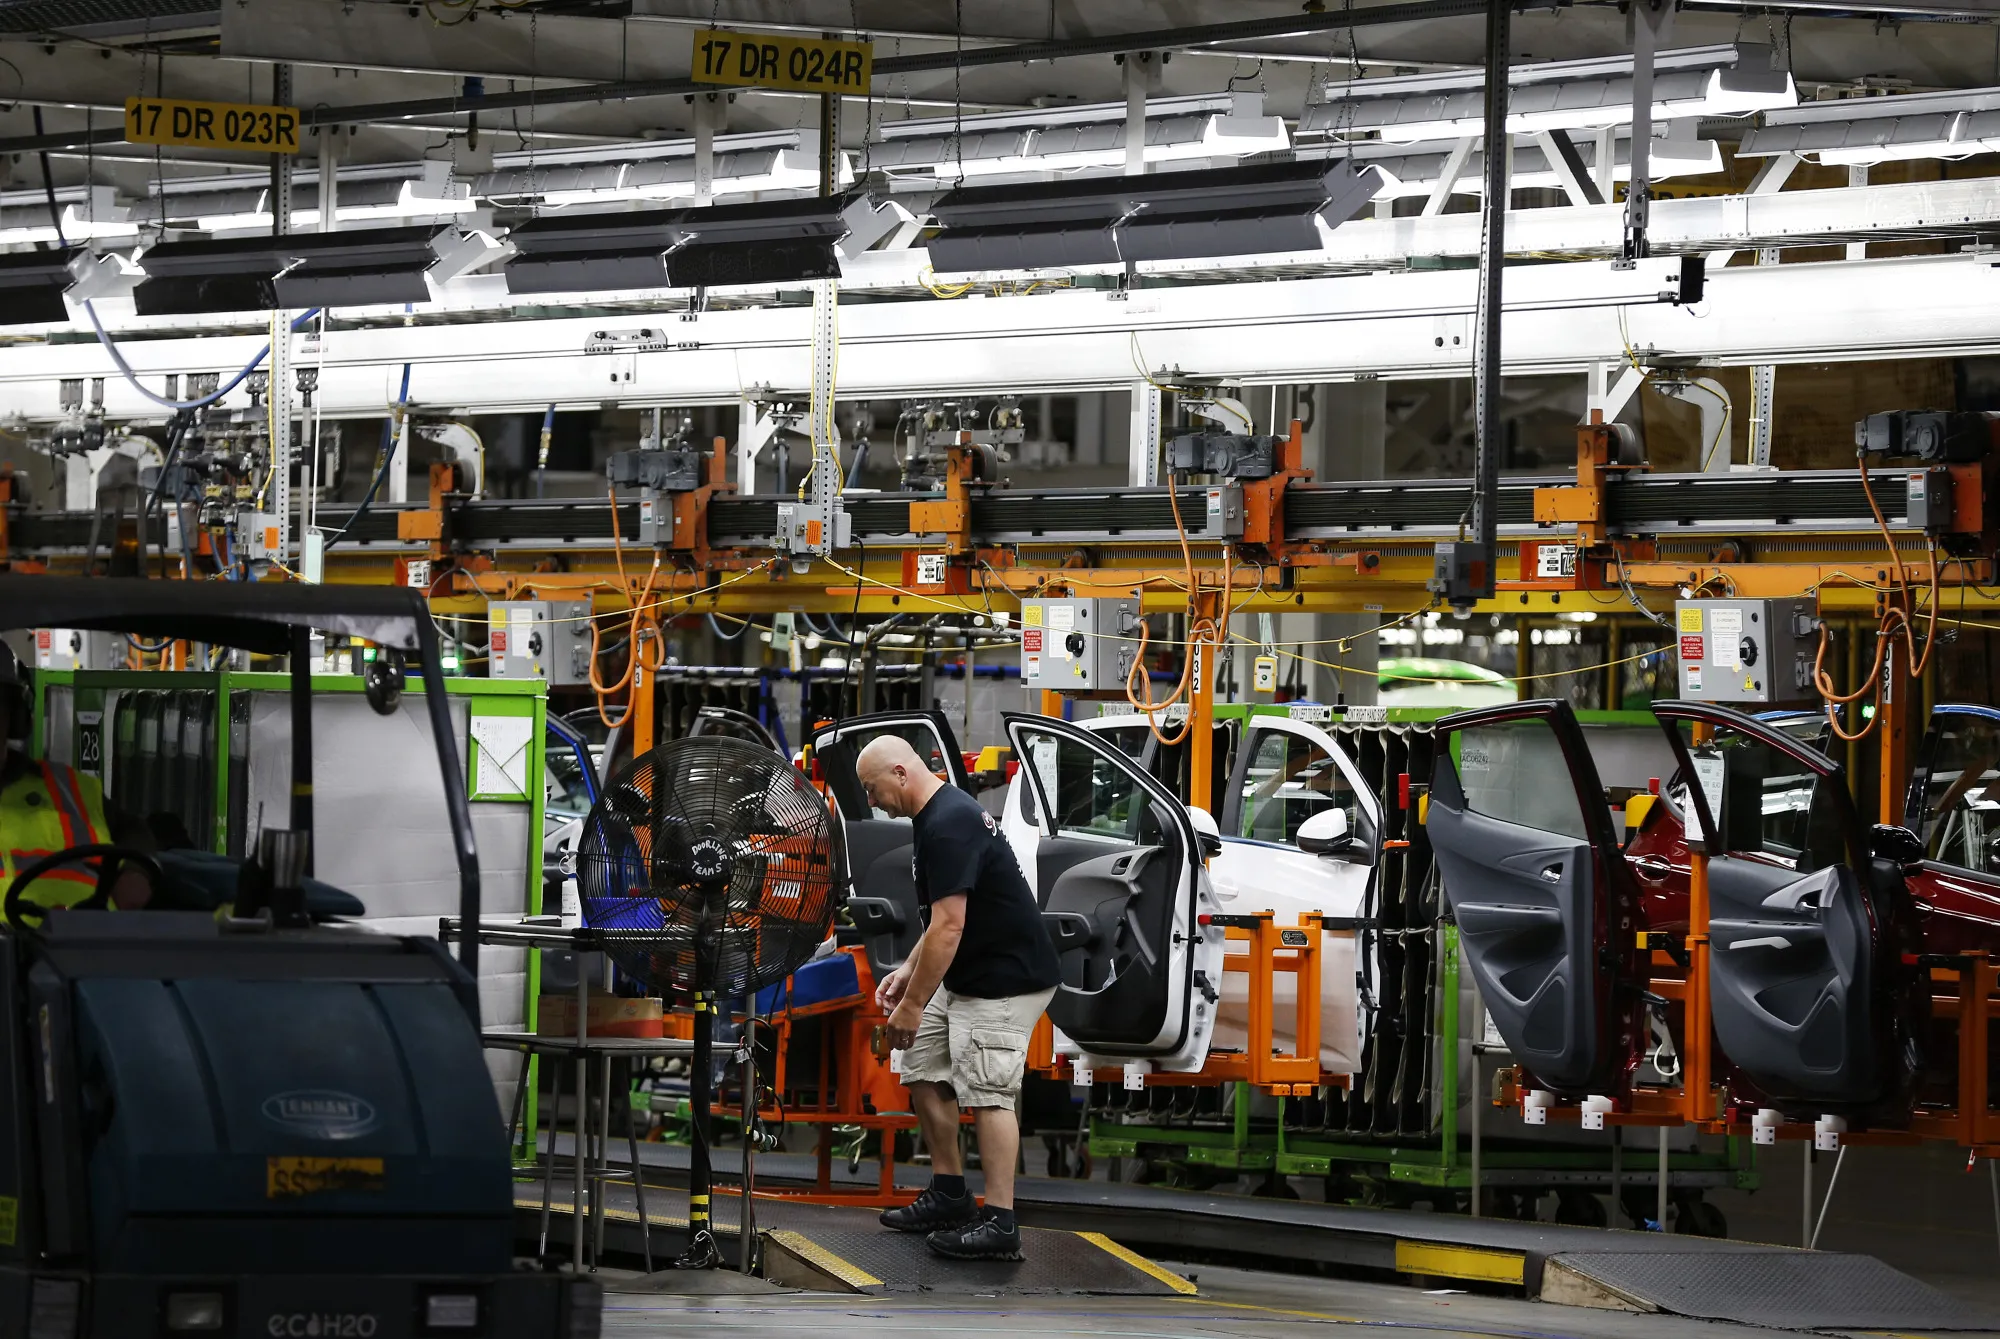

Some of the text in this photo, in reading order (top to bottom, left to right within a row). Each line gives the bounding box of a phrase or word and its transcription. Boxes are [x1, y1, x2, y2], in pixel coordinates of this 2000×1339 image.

[702, 40, 863, 86] 17 DR 024R
[131, 104, 295, 145] 17 DR 023R
[82, 731, 99, 761] 28
[692, 840, 728, 861] DOORLINE
